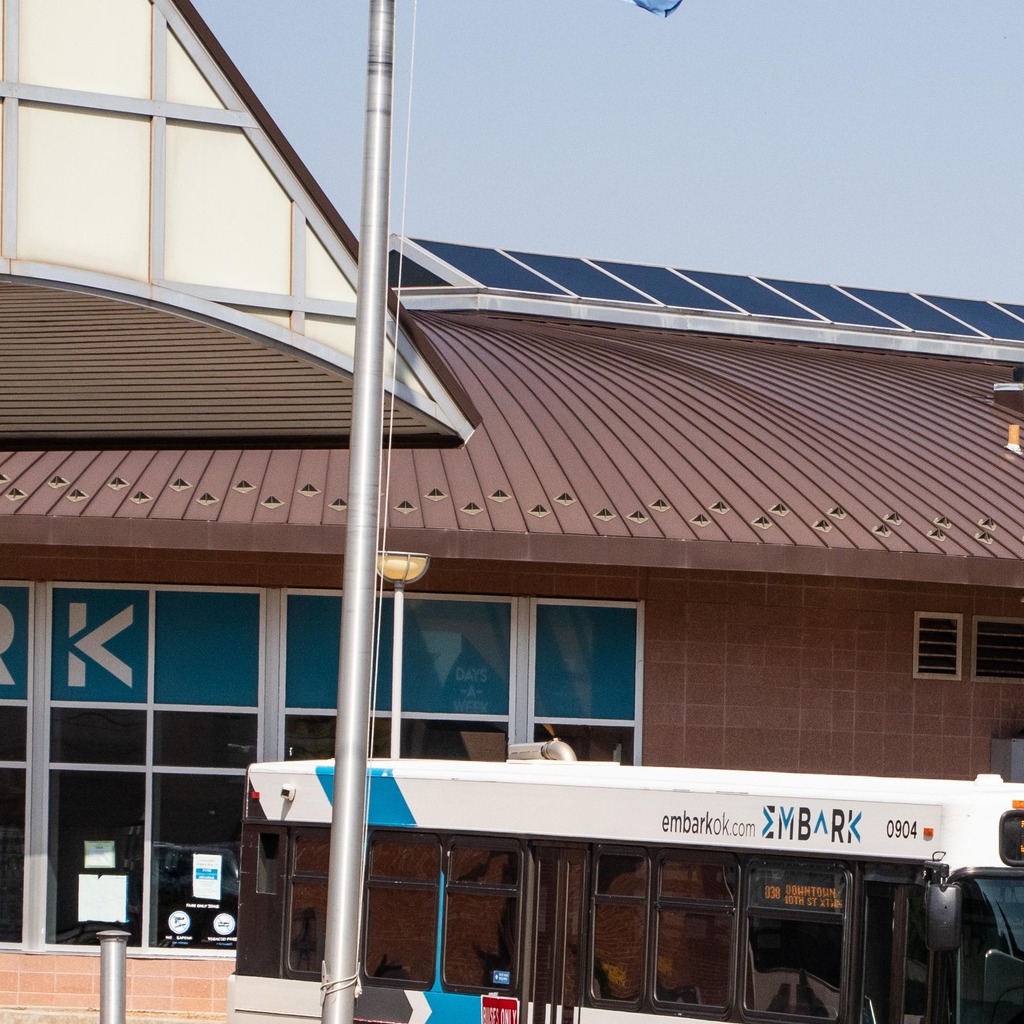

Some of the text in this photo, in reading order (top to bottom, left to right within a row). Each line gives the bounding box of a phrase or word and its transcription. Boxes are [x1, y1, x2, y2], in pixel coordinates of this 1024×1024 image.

[456, 667, 488, 682] DAYS
[661, 810, 756, 838] embarkok.com
[761, 805, 863, 844] EMBARK
[886, 819, 918, 840] 0904
